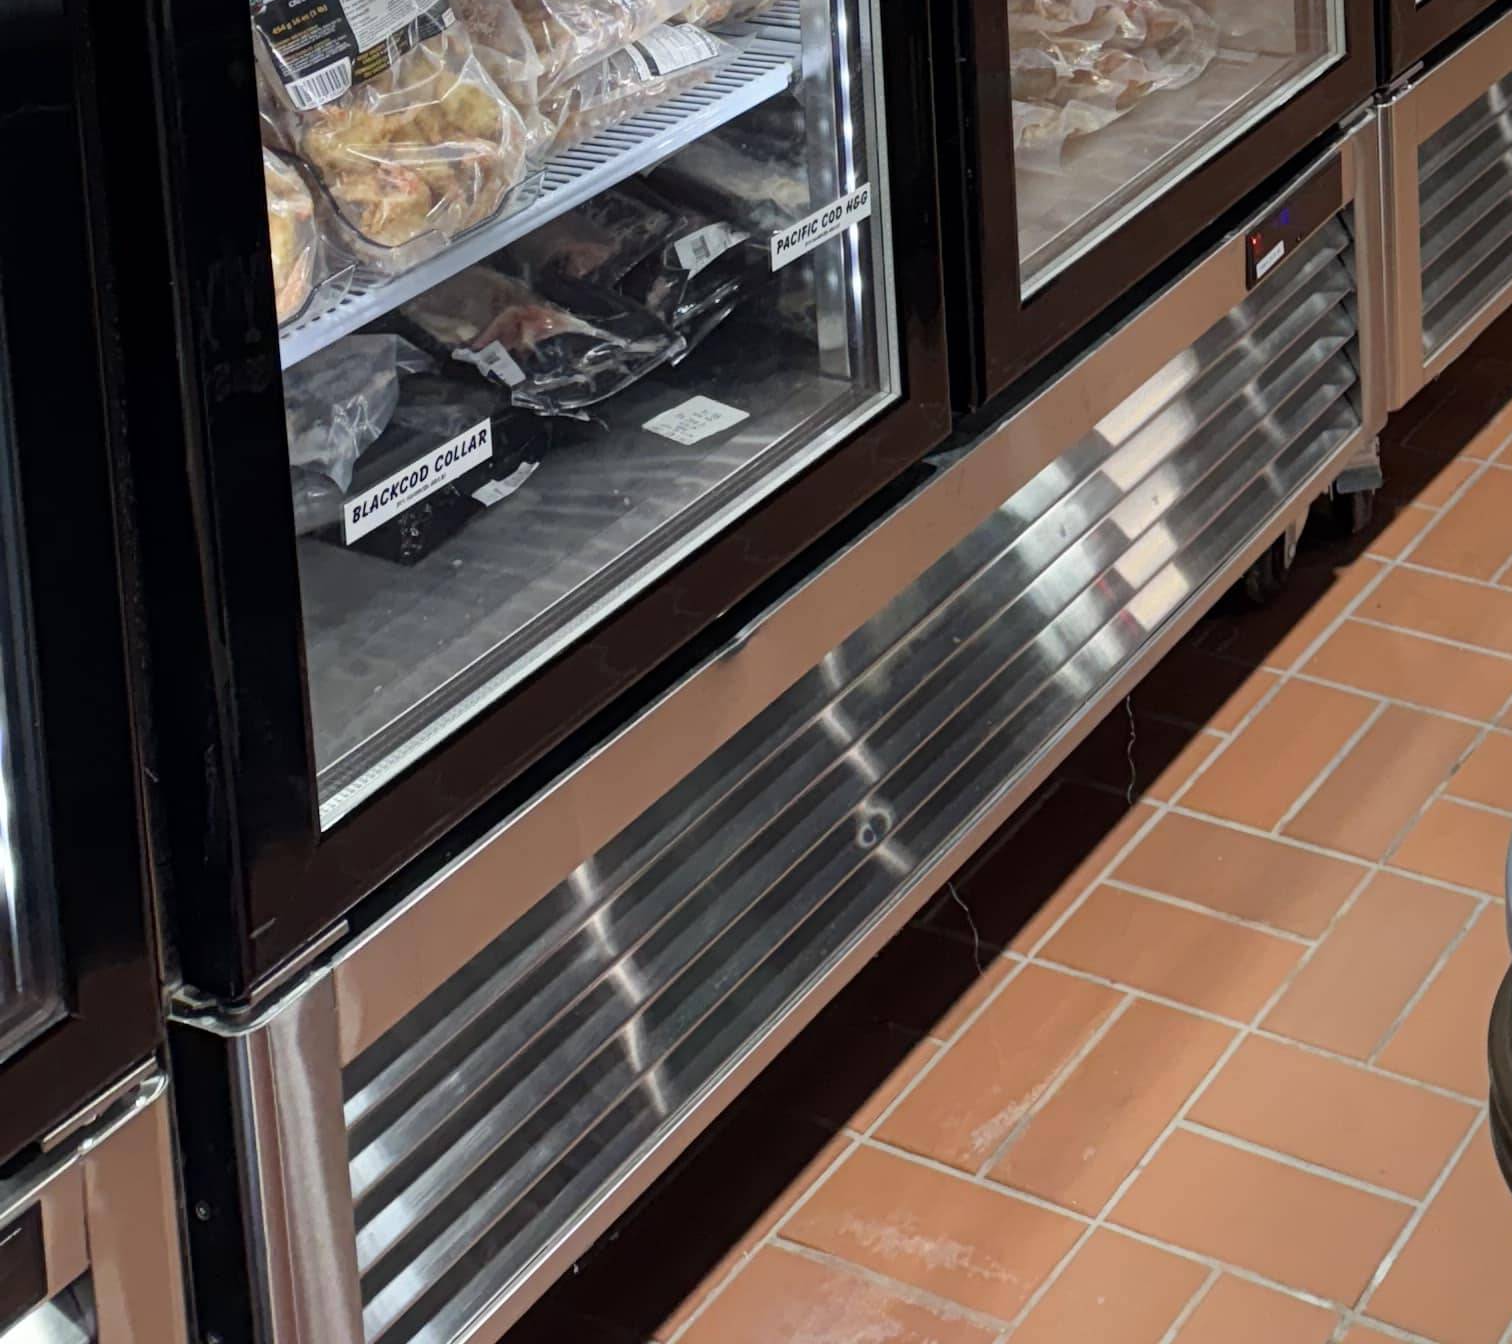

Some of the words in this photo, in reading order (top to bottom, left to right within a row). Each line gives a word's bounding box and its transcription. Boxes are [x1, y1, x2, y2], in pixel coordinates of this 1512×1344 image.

[777, 219, 819, 254] PACIFIC
[821, 205, 843, 229] COD
[845, 190, 868, 214] H&G
[352, 465, 429, 524] BLACKCOD
[434, 428, 488, 473] COLLAR
